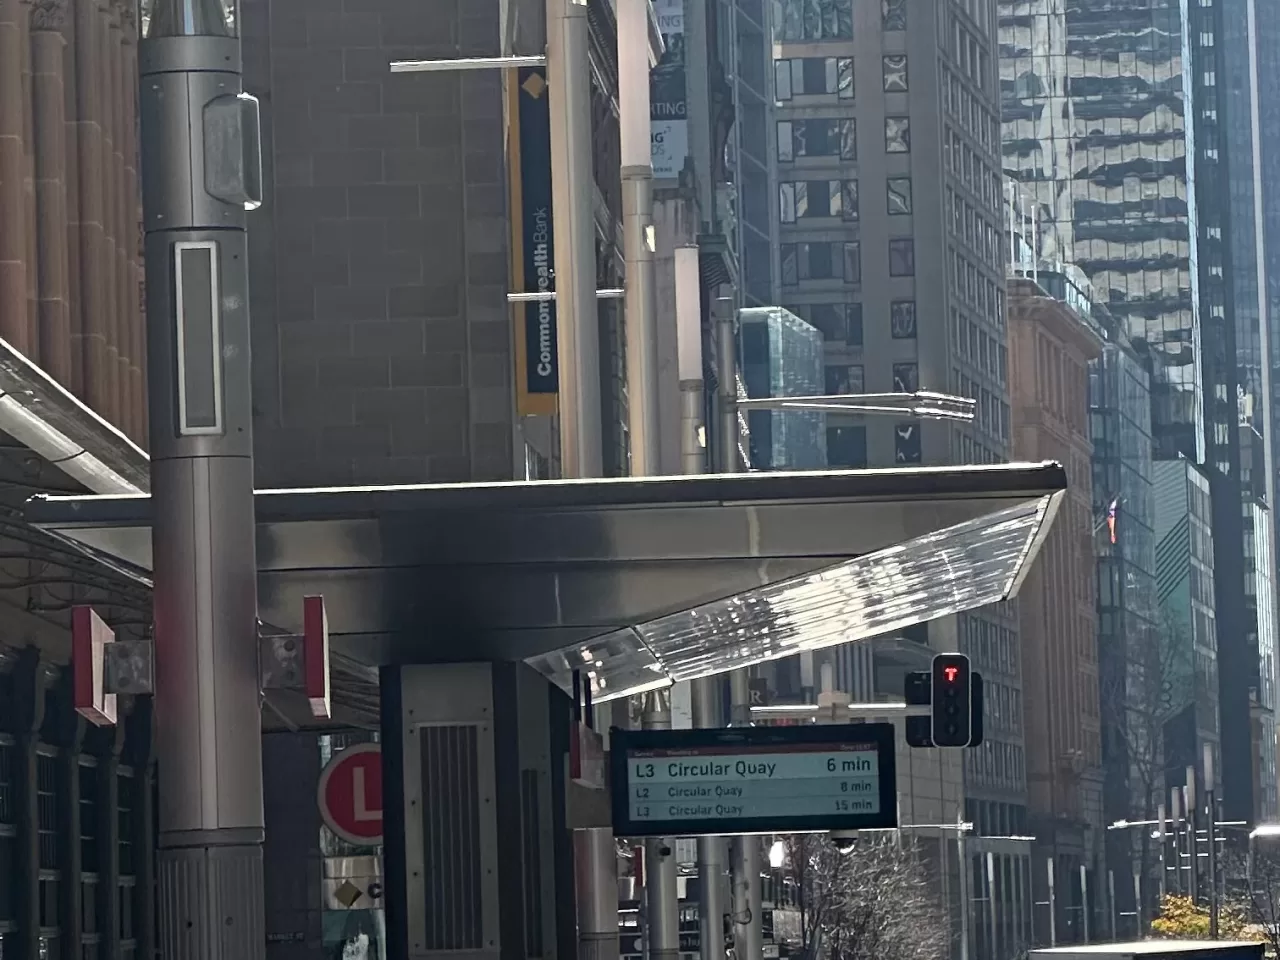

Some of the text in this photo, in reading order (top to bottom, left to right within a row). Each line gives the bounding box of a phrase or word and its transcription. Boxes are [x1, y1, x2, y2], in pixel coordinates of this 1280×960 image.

[636, 756, 871, 778] L3 Circular Quay 6 min
[636, 788, 650, 798] L2
[668, 786, 712, 797] Circular
[715, 785, 743, 797] Quay
[851, 781, 872, 792] min
[668, 804, 712, 816] Circular
[715, 803, 744, 816] Quay
[835, 800, 849, 811] 15
[852, 799, 873, 810] min
